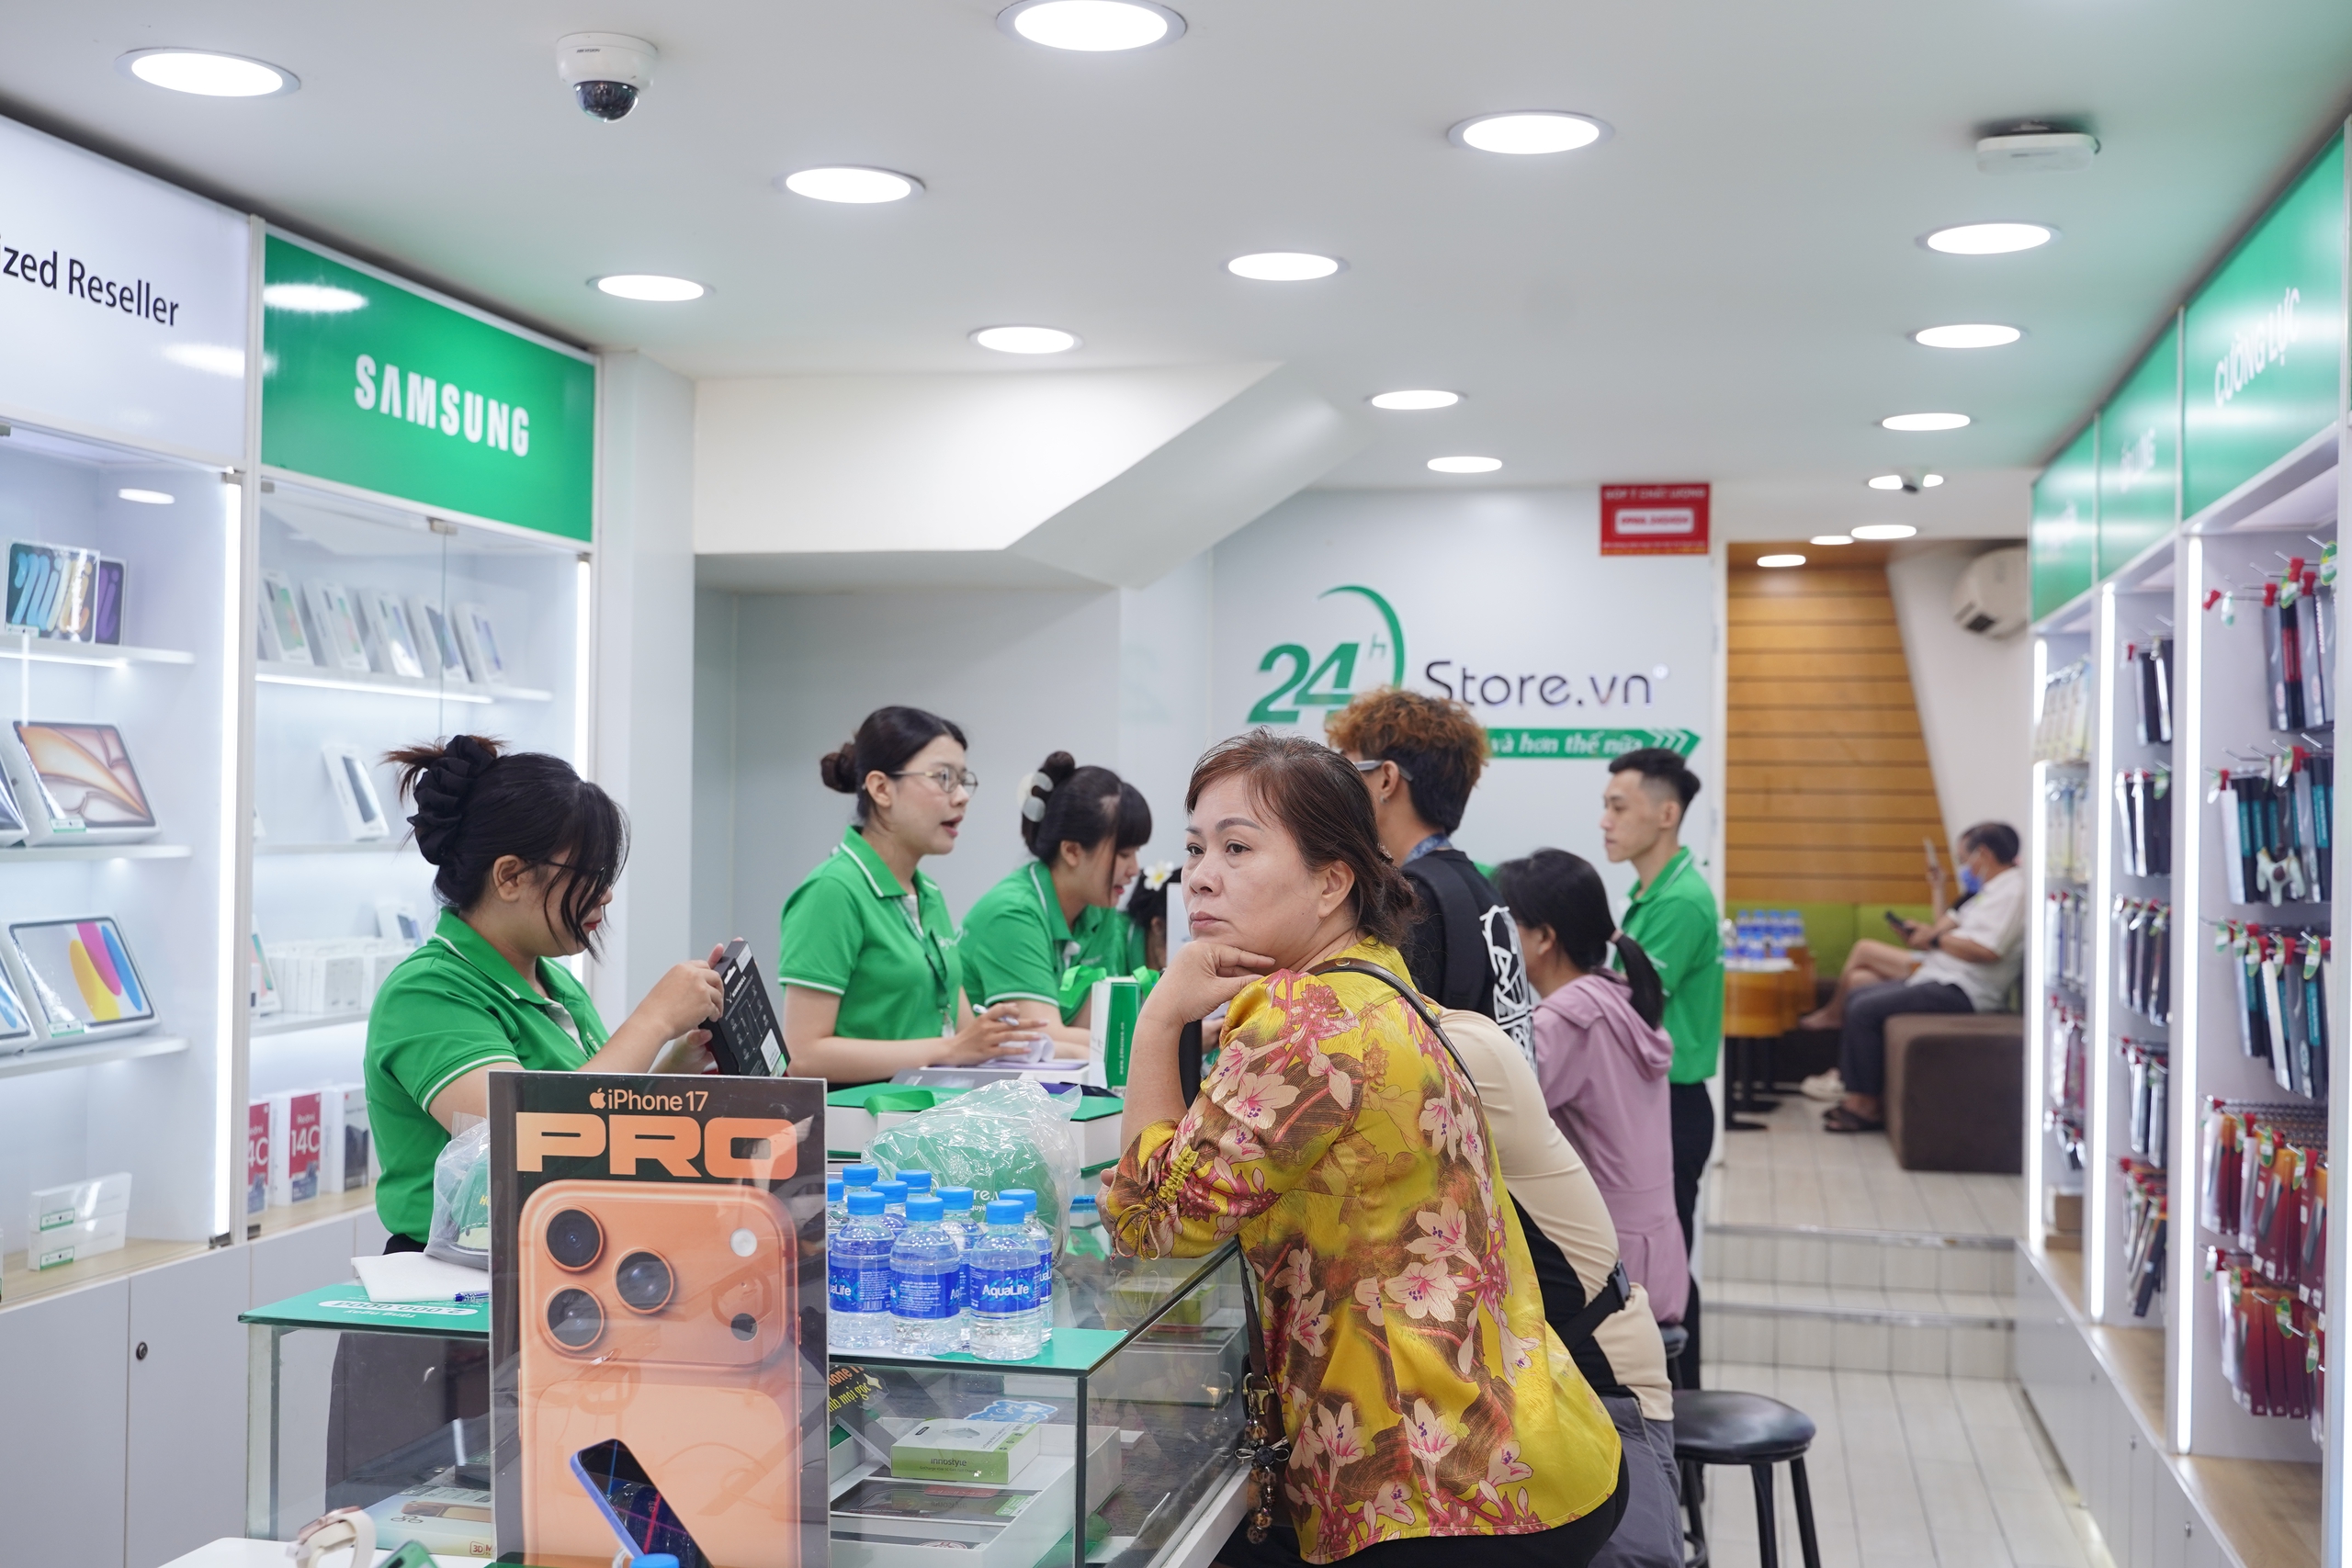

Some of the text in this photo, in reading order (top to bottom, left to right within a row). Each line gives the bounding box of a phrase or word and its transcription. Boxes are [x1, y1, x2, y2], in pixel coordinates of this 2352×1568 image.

[68, 257, 180, 327] Reseller
[354, 353, 530, 457] SAMSUNG
[1424, 660, 1653, 708] Store.vn
[1518, 731, 1560, 754] hơn
[1564, 729, 1606, 754] thế
[607, 1089, 709, 1112] iPhone 17
[296, 1112, 316, 1125] Redmi
[247, 1135, 269, 1169] 4C
[290, 1123, 321, 1158] 14C
[515, 1111, 798, 1181] PRO
[981, 1282, 1030, 1300] AquaLife
[472, 1544, 483, 1553] 3D
